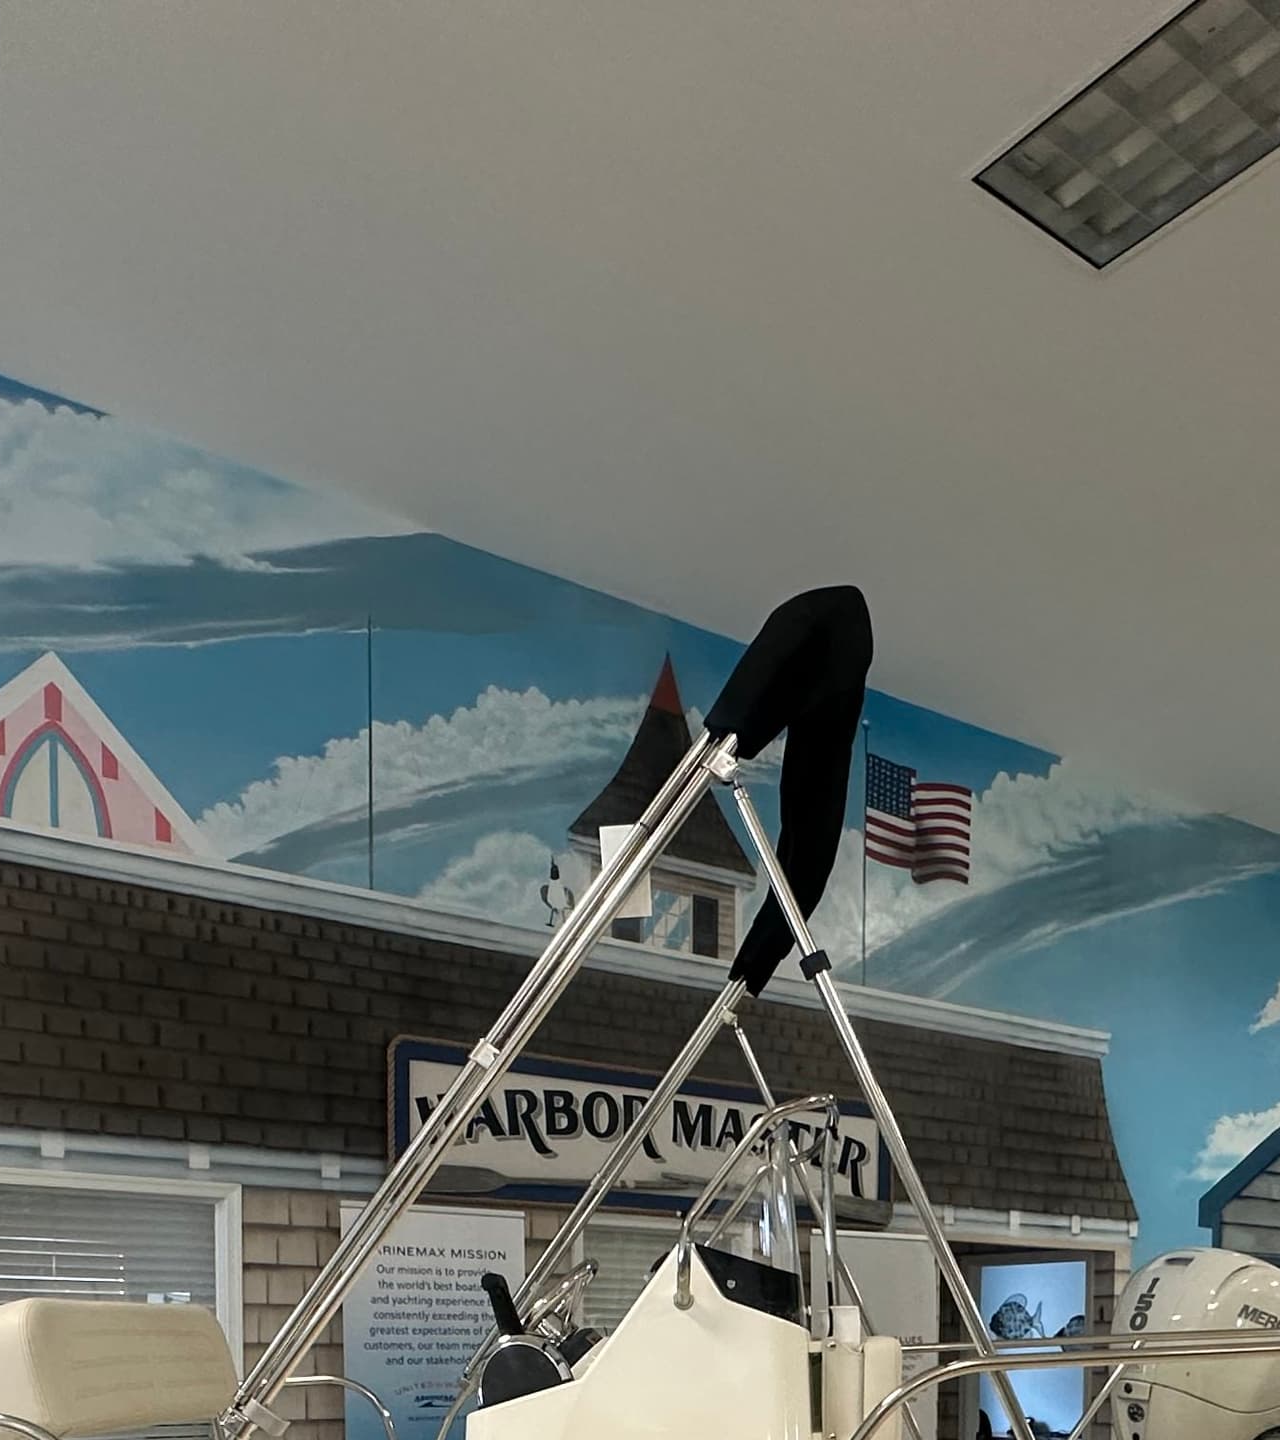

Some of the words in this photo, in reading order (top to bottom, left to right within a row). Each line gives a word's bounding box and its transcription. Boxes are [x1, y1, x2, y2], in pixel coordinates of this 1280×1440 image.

[378, 1245, 446, 1258] RINEMAX
[450, 1248, 507, 1261] MISSION
[376, 1263, 395, 1275] Our
[397, 1264, 433, 1276] mission
[435, 1266, 442, 1277] is
[445, 1267, 455, 1277] to
[378, 1279, 394, 1290] the
[433, 1281, 452, 1291] best
[370, 1295, 390, 1305] and
[391, 1295, 433, 1307] yachting
[435, 1297, 485, 1308] experience
[373, 1310, 431, 1322] consistently
[432, 1311, 479, 1323] exceeding
[369, 1326, 410, 1337] greatest
[411, 1326, 471, 1337] expectations
[473, 1327, 483, 1336] of
[417, 1343, 434, 1351] our
[436, 1342, 460, 1351] team
[385, 1356, 404, 1366] and
[406, 1357, 423, 1366] our
